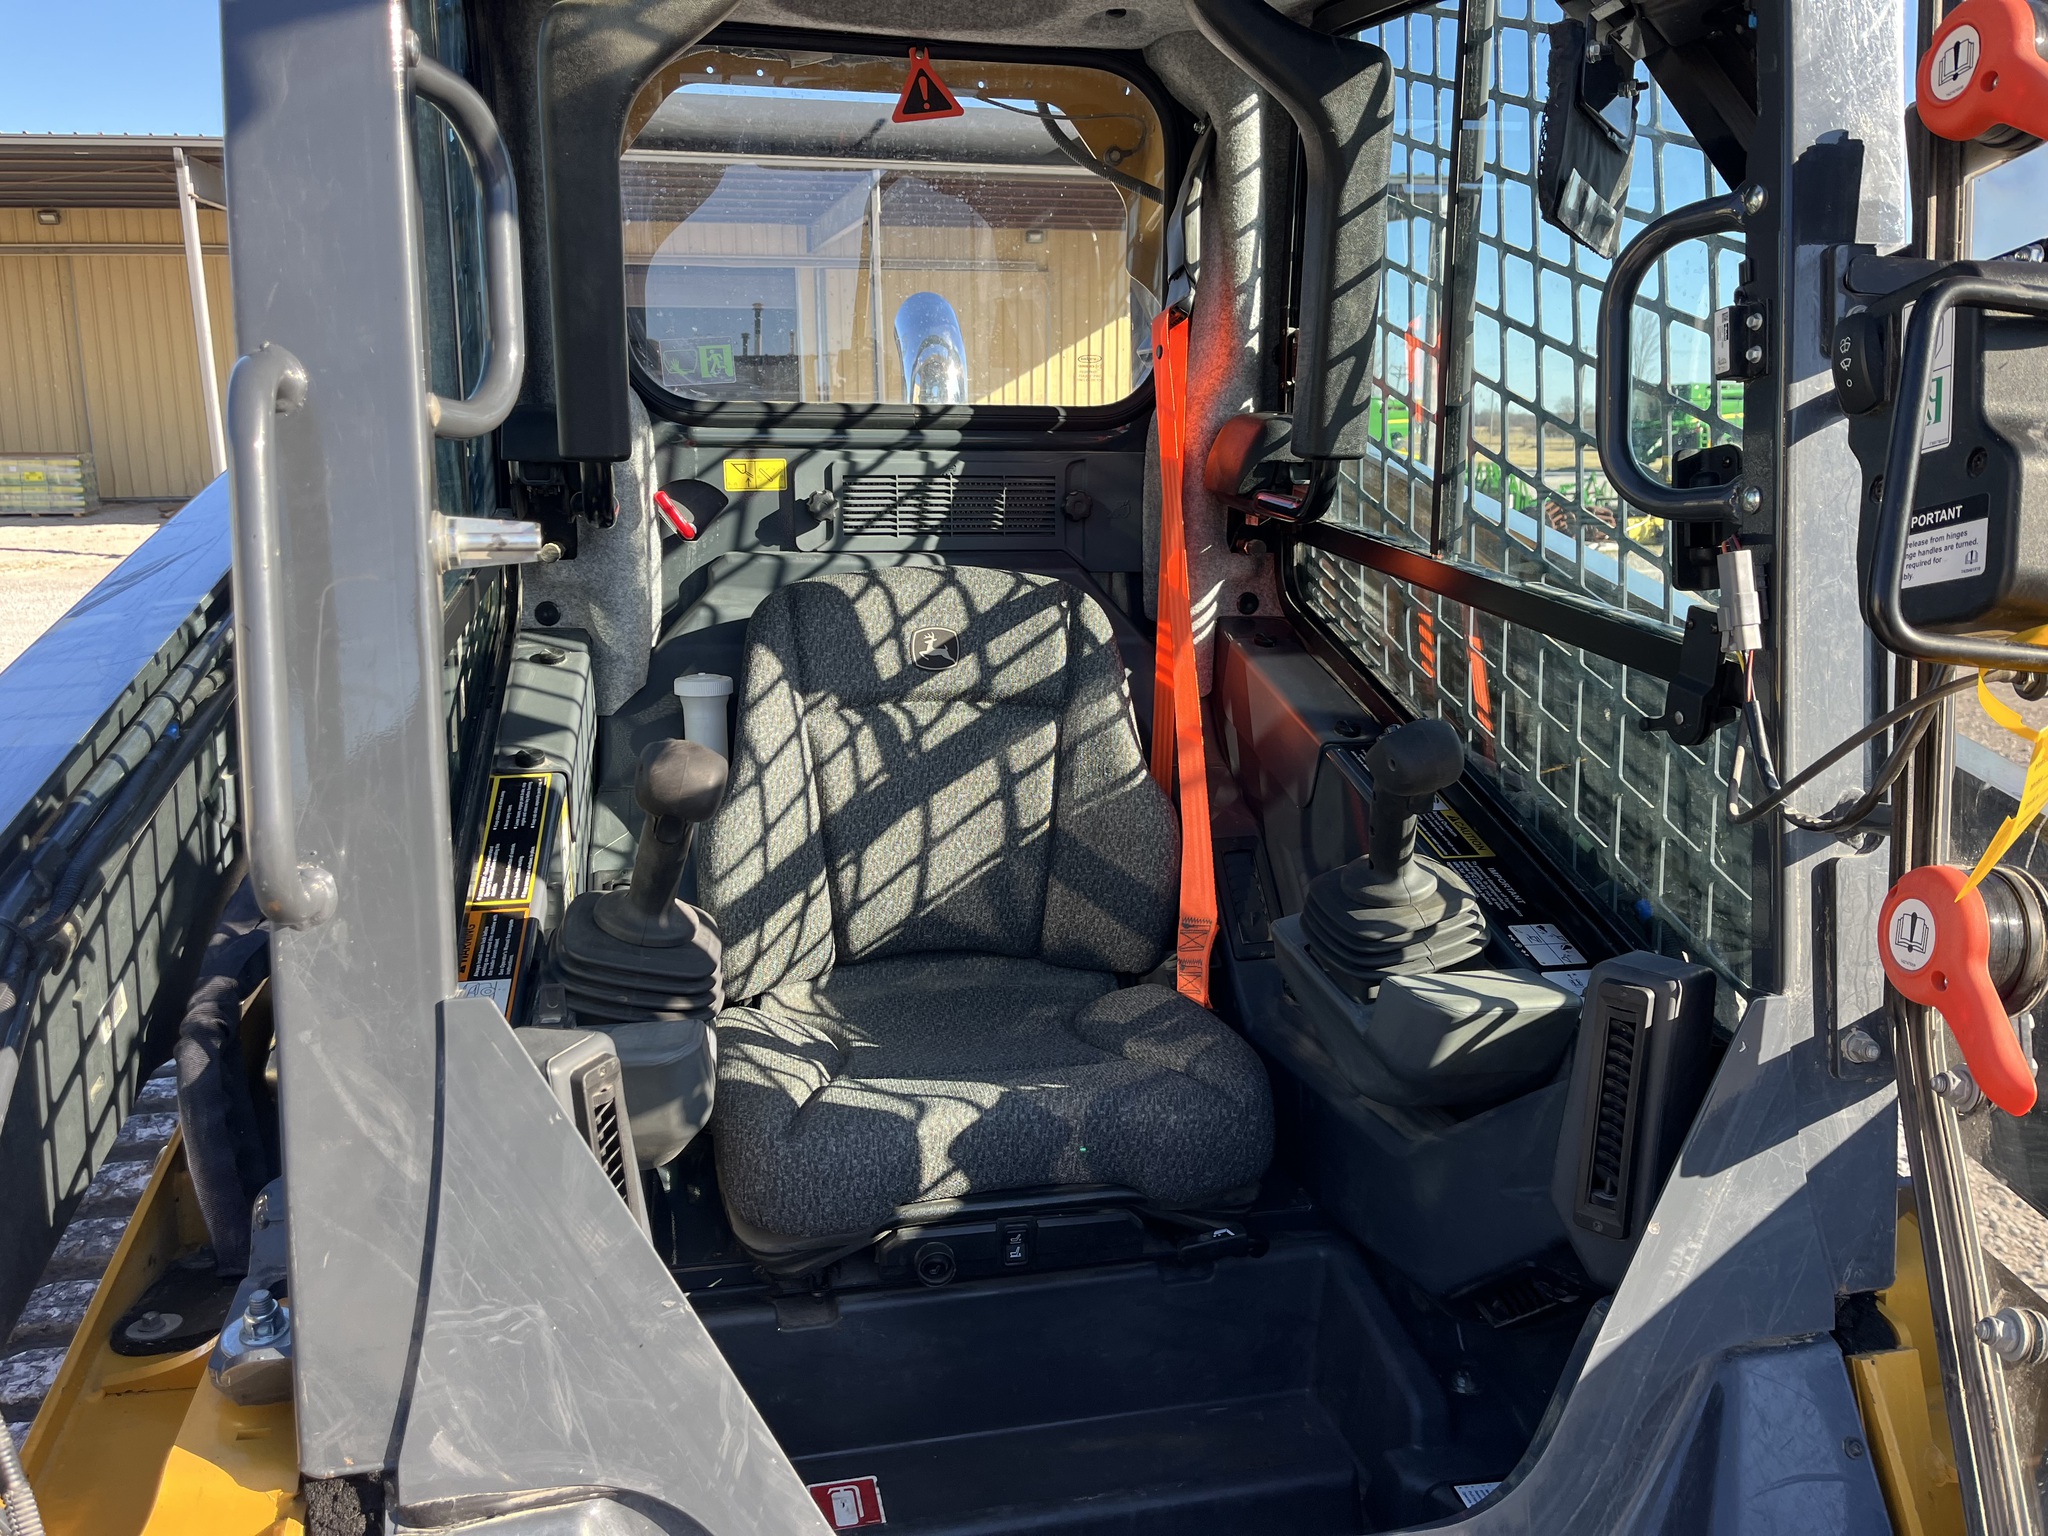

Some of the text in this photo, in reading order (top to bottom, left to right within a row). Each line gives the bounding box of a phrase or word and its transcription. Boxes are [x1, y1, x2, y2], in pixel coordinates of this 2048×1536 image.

[1911, 505, 1963, 529] PORTANT
[1930, 535, 1944, 543] from
[1946, 530, 1968, 541] hinges
[1918, 547, 1942, 557] handles
[1906, 559, 1931, 570] required
[1455, 819, 1486, 851] CAUTION
[1487, 867, 1526, 905] IMPORTANT
